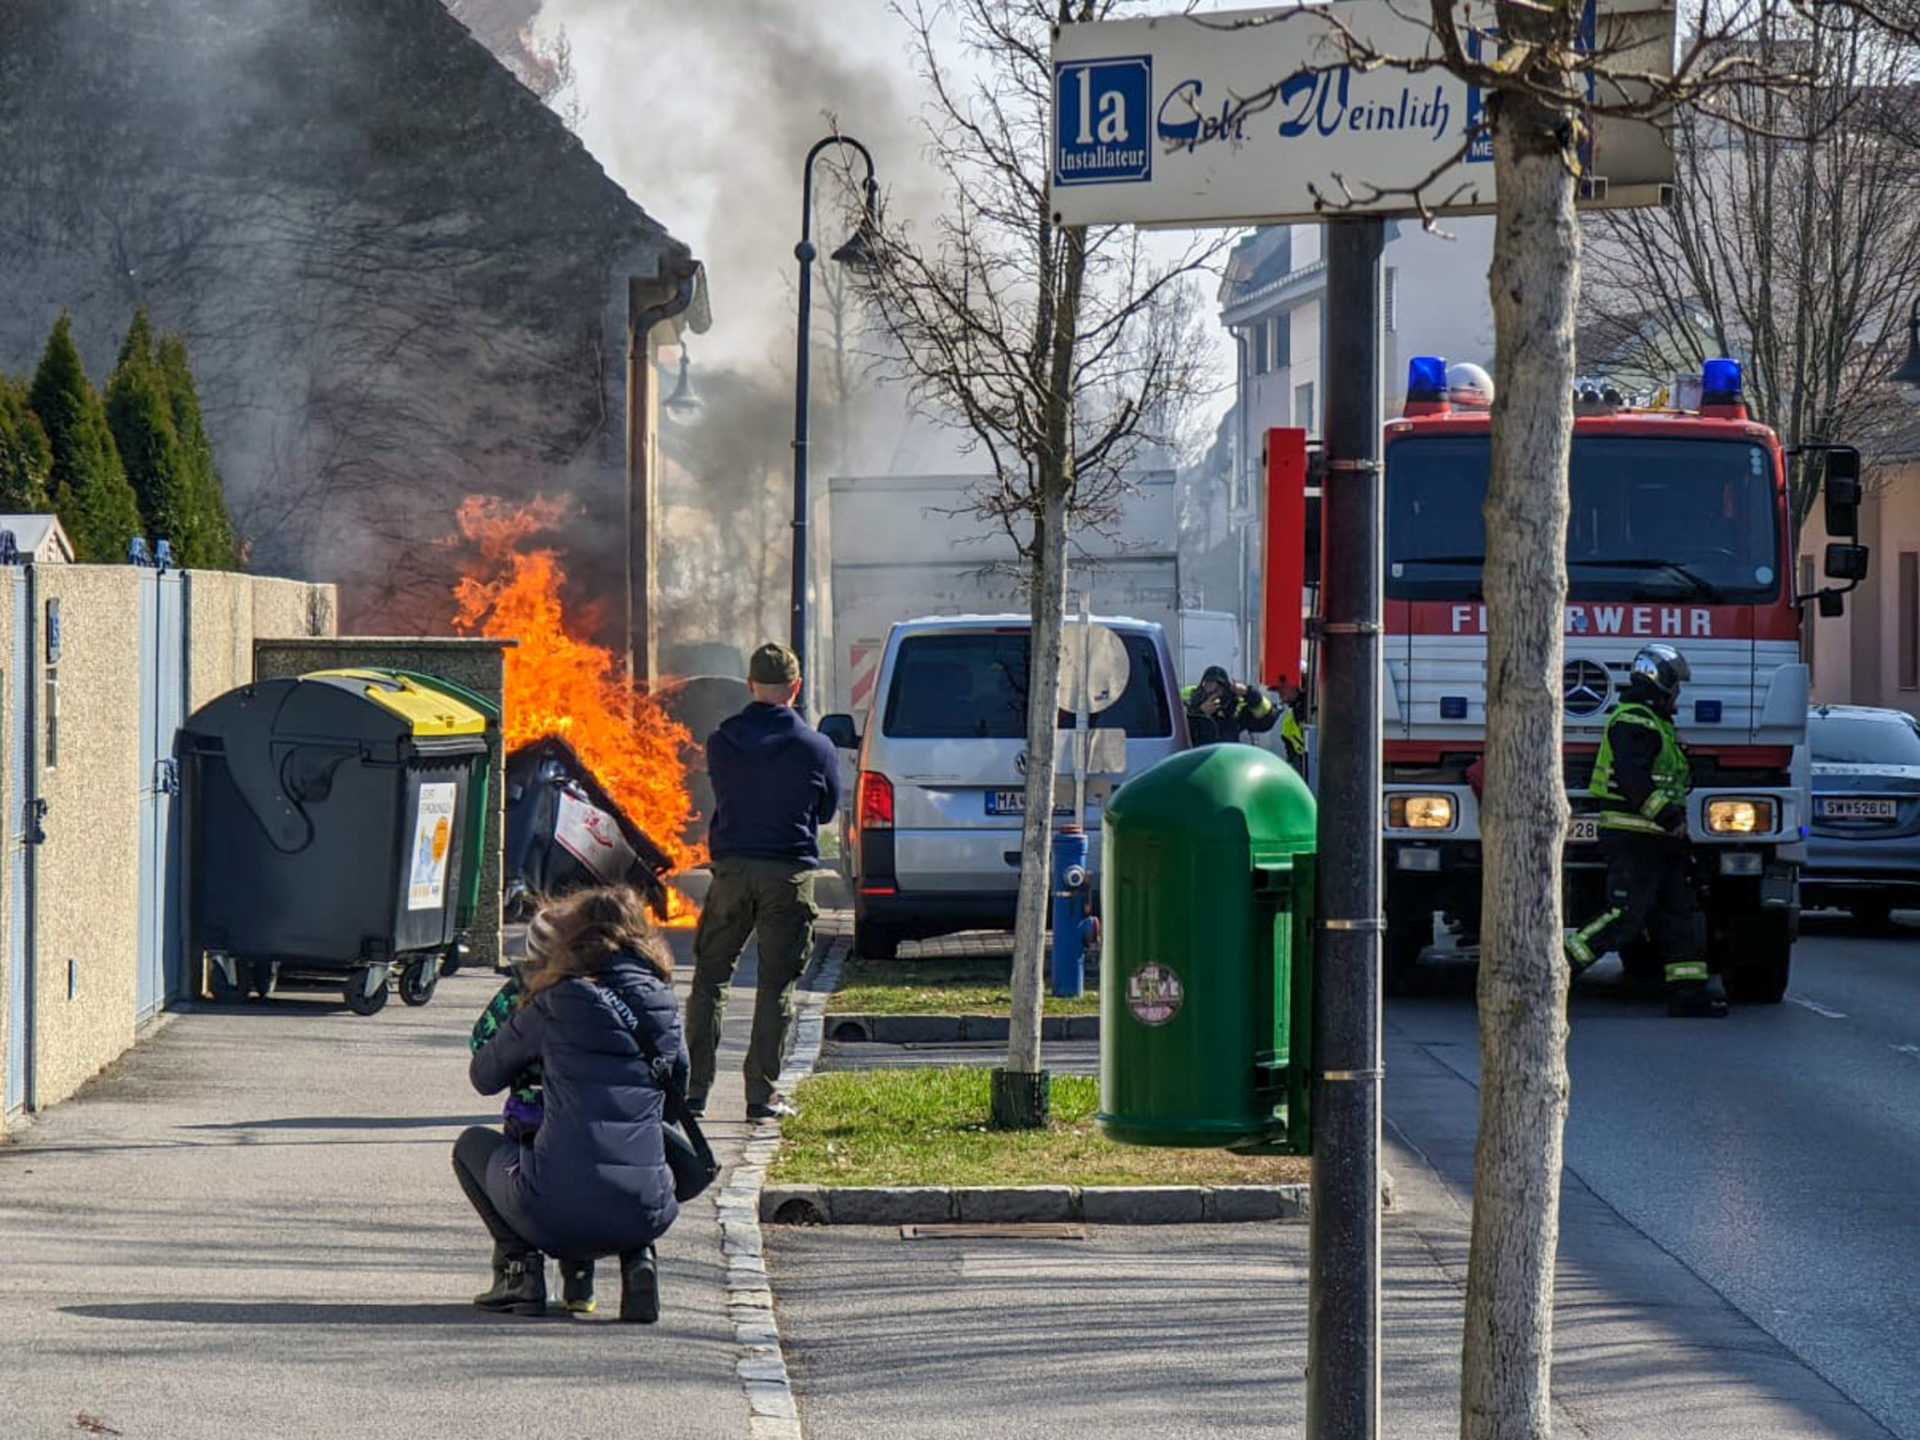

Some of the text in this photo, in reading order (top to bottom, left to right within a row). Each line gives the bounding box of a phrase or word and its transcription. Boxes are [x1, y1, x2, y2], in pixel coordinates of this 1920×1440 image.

[1075, 67, 1128, 144] 1a
[1278, 66, 1449, 141] Weinlich
[1061, 145, 1145, 171] Installateur
